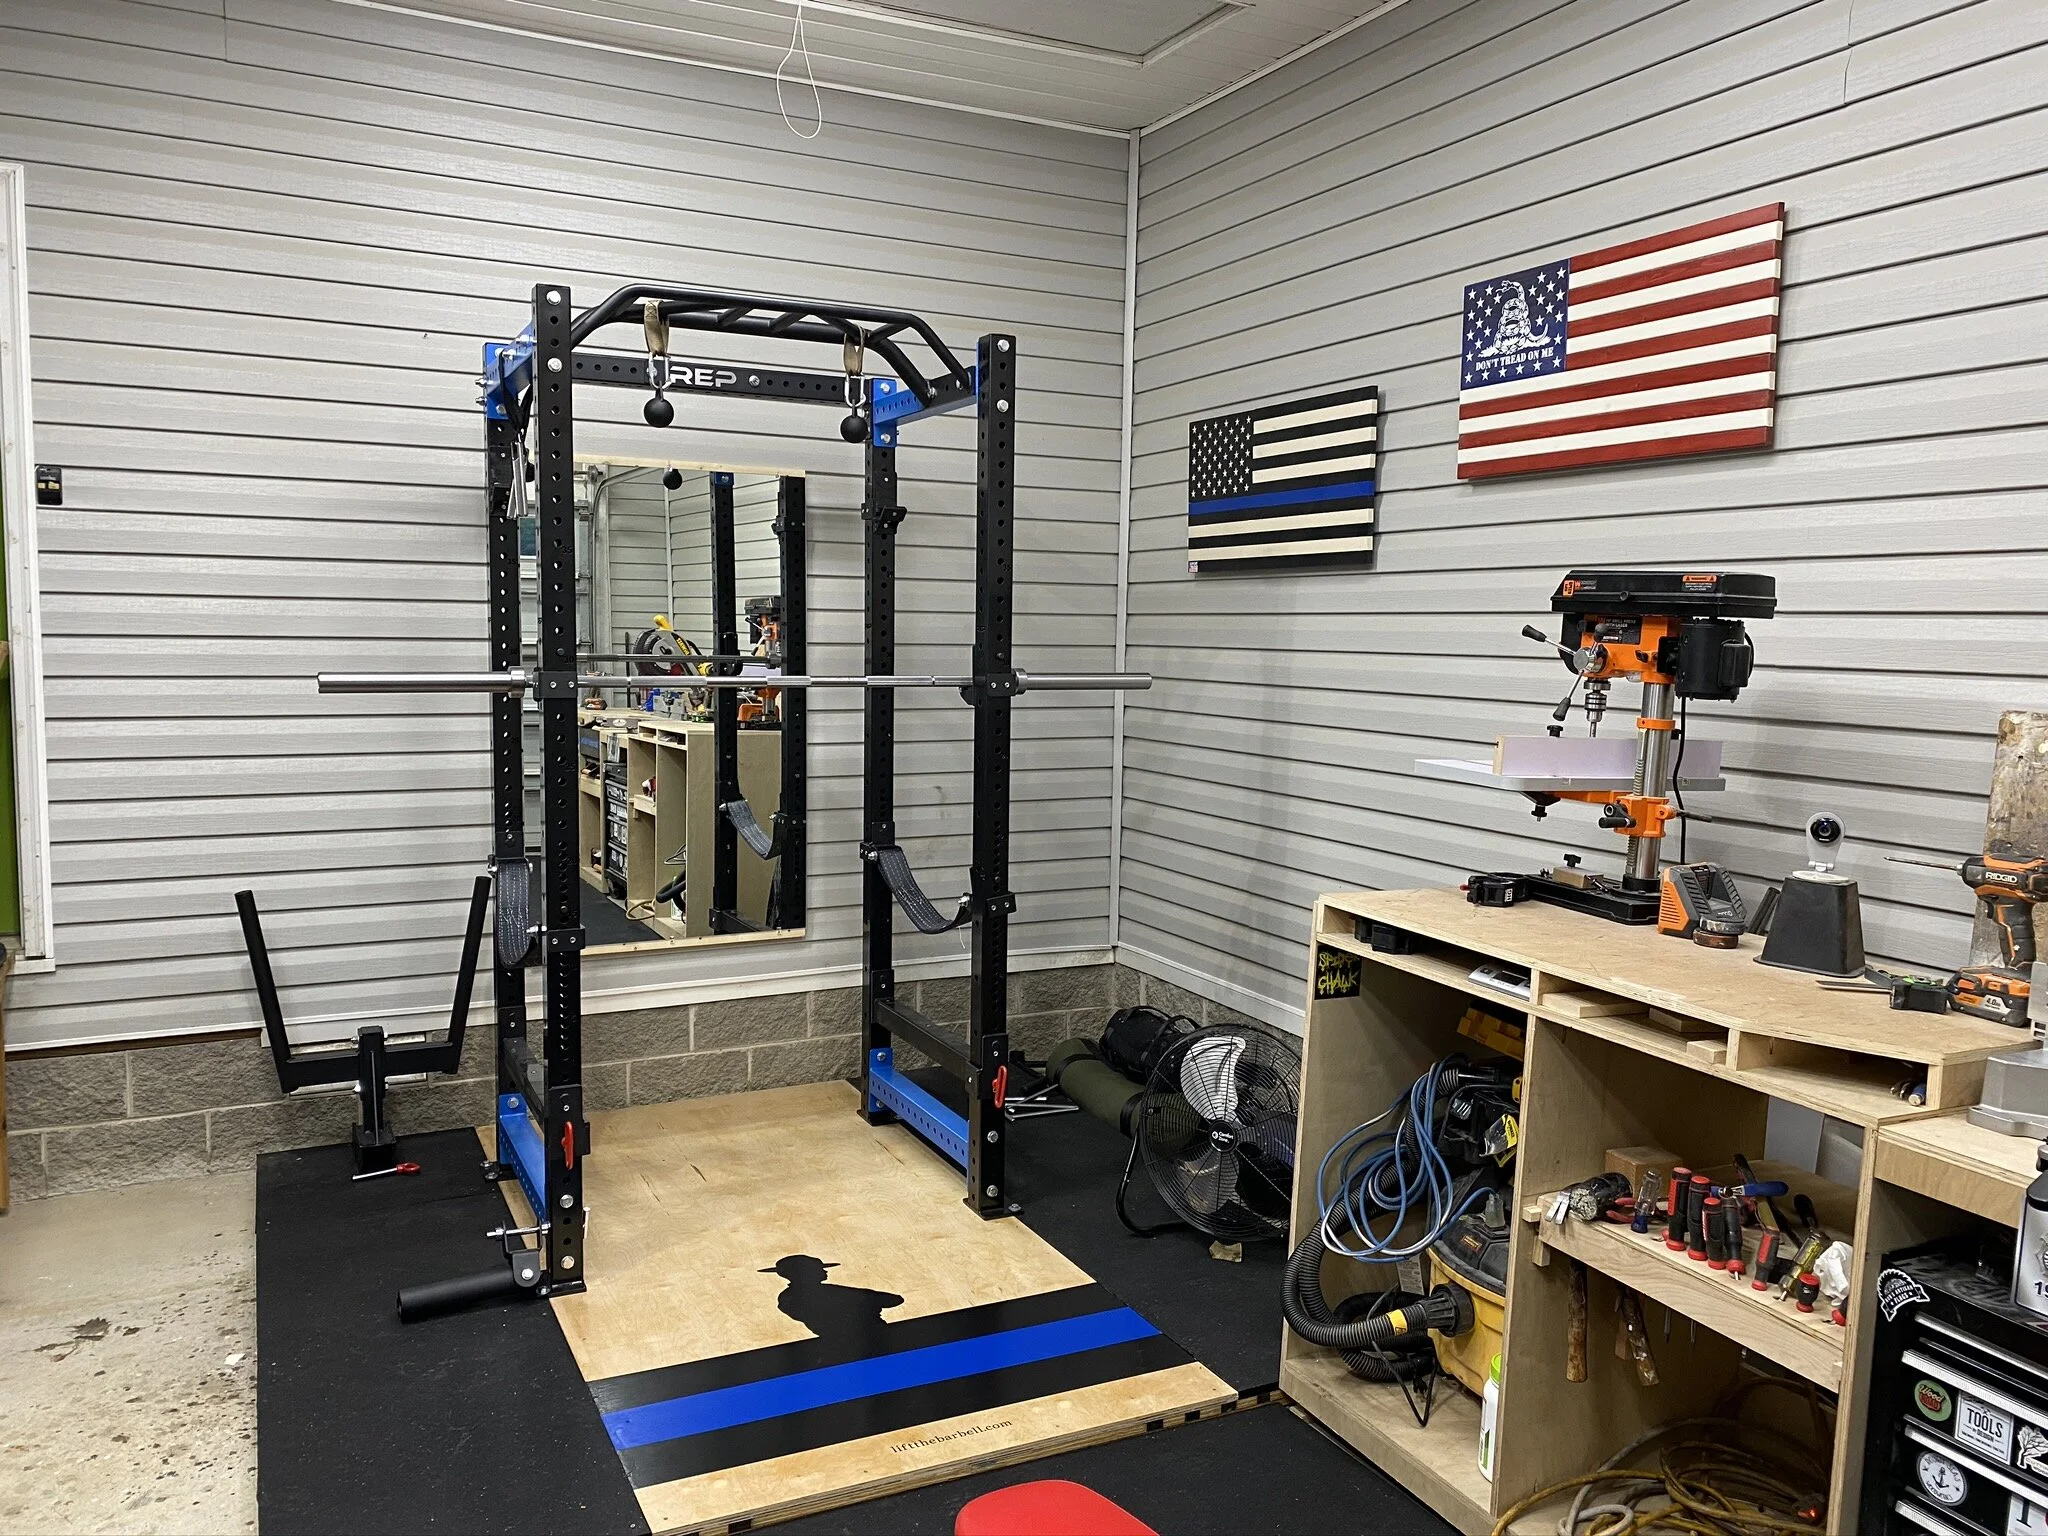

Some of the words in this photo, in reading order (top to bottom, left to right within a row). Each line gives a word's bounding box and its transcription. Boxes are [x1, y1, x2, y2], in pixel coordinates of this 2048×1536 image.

[1475, 358, 1500, 371] DON'T
[1500, 353, 1527, 366] TREAD
[1527, 349, 1540, 361] ON
[1541, 347, 1554, 358] ME
[669, 365, 737, 388] REP
[562, 545, 573, 554] 35
[1985, 871, 2018, 884] RIDGID
[1317, 969, 1360, 996] CHALK
[1919, 1384, 1945, 1403] Wood
[1966, 1407, 2004, 1439] TOOLS
[890, 1419, 1013, 1453] liftthebarbell.com
